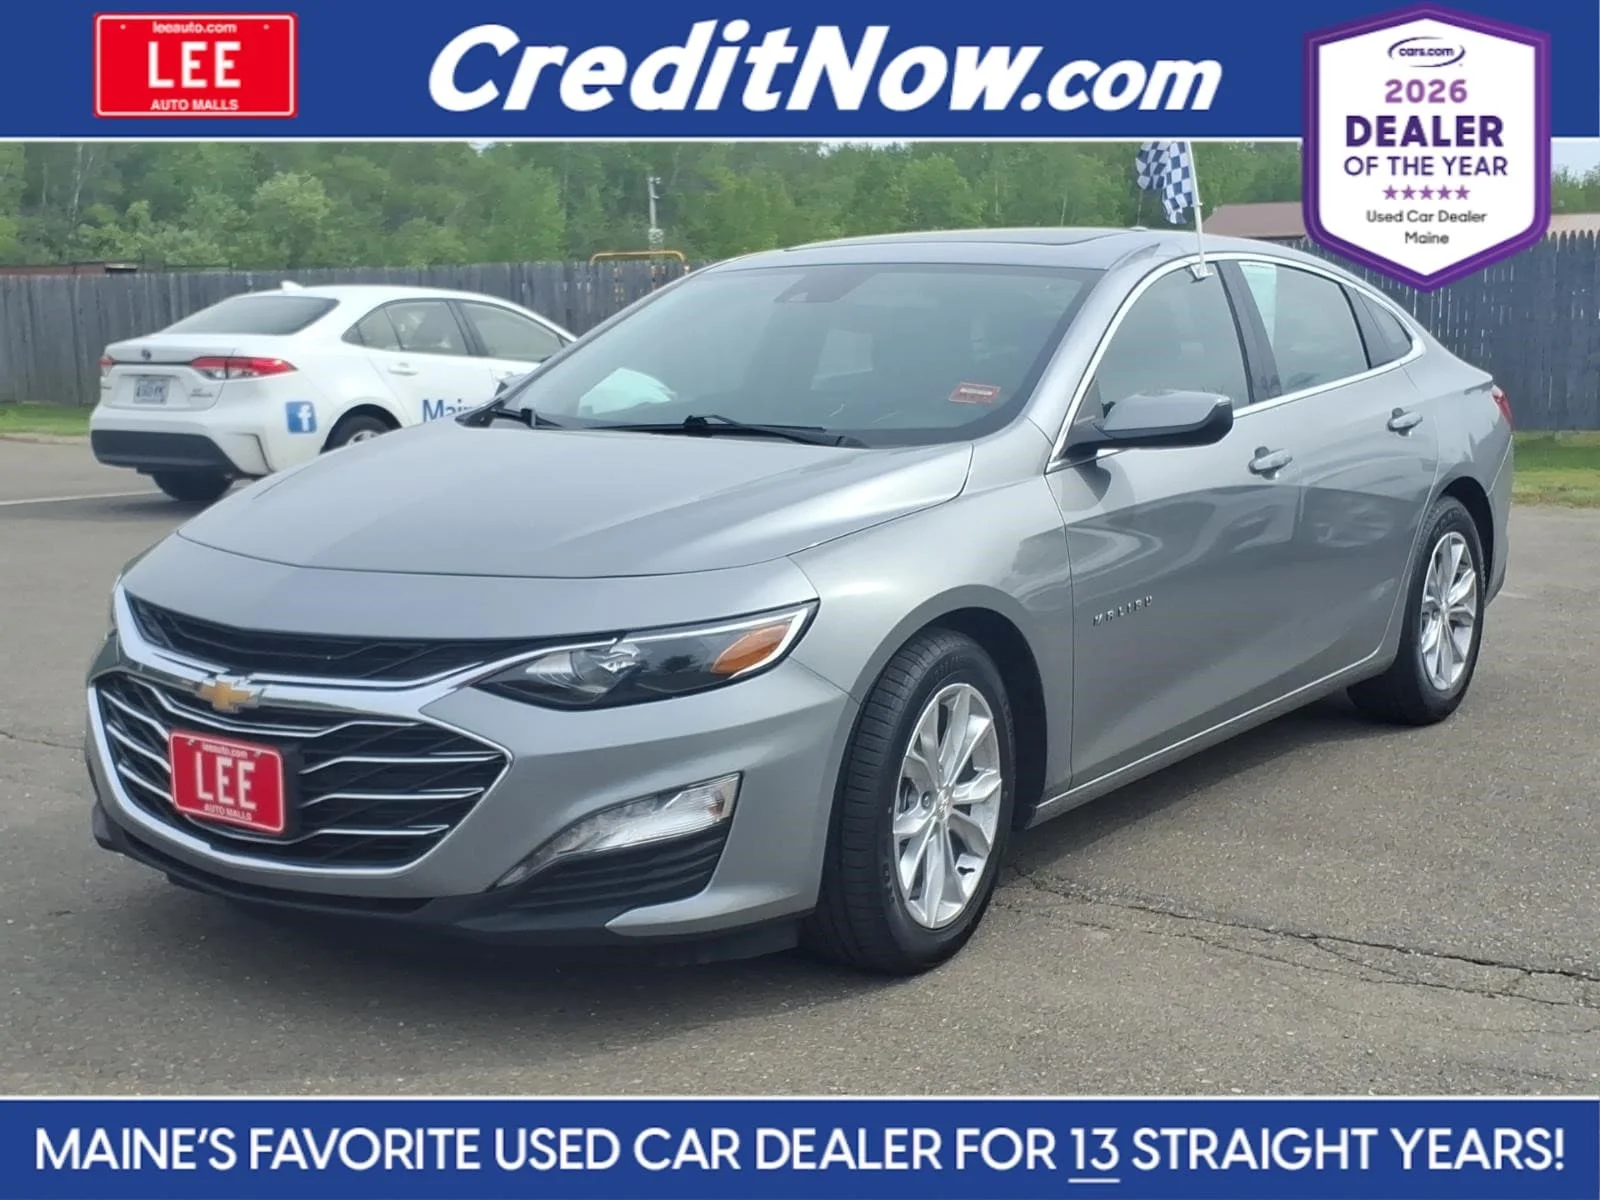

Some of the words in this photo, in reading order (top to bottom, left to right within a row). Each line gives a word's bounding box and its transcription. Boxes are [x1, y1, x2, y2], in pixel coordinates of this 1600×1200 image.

[1092, 594, 1153, 626] MALIBU
[195, 751, 257, 810] LEE
[204, 803, 225, 816] AUTO
[226, 808, 253, 821] MALLS
